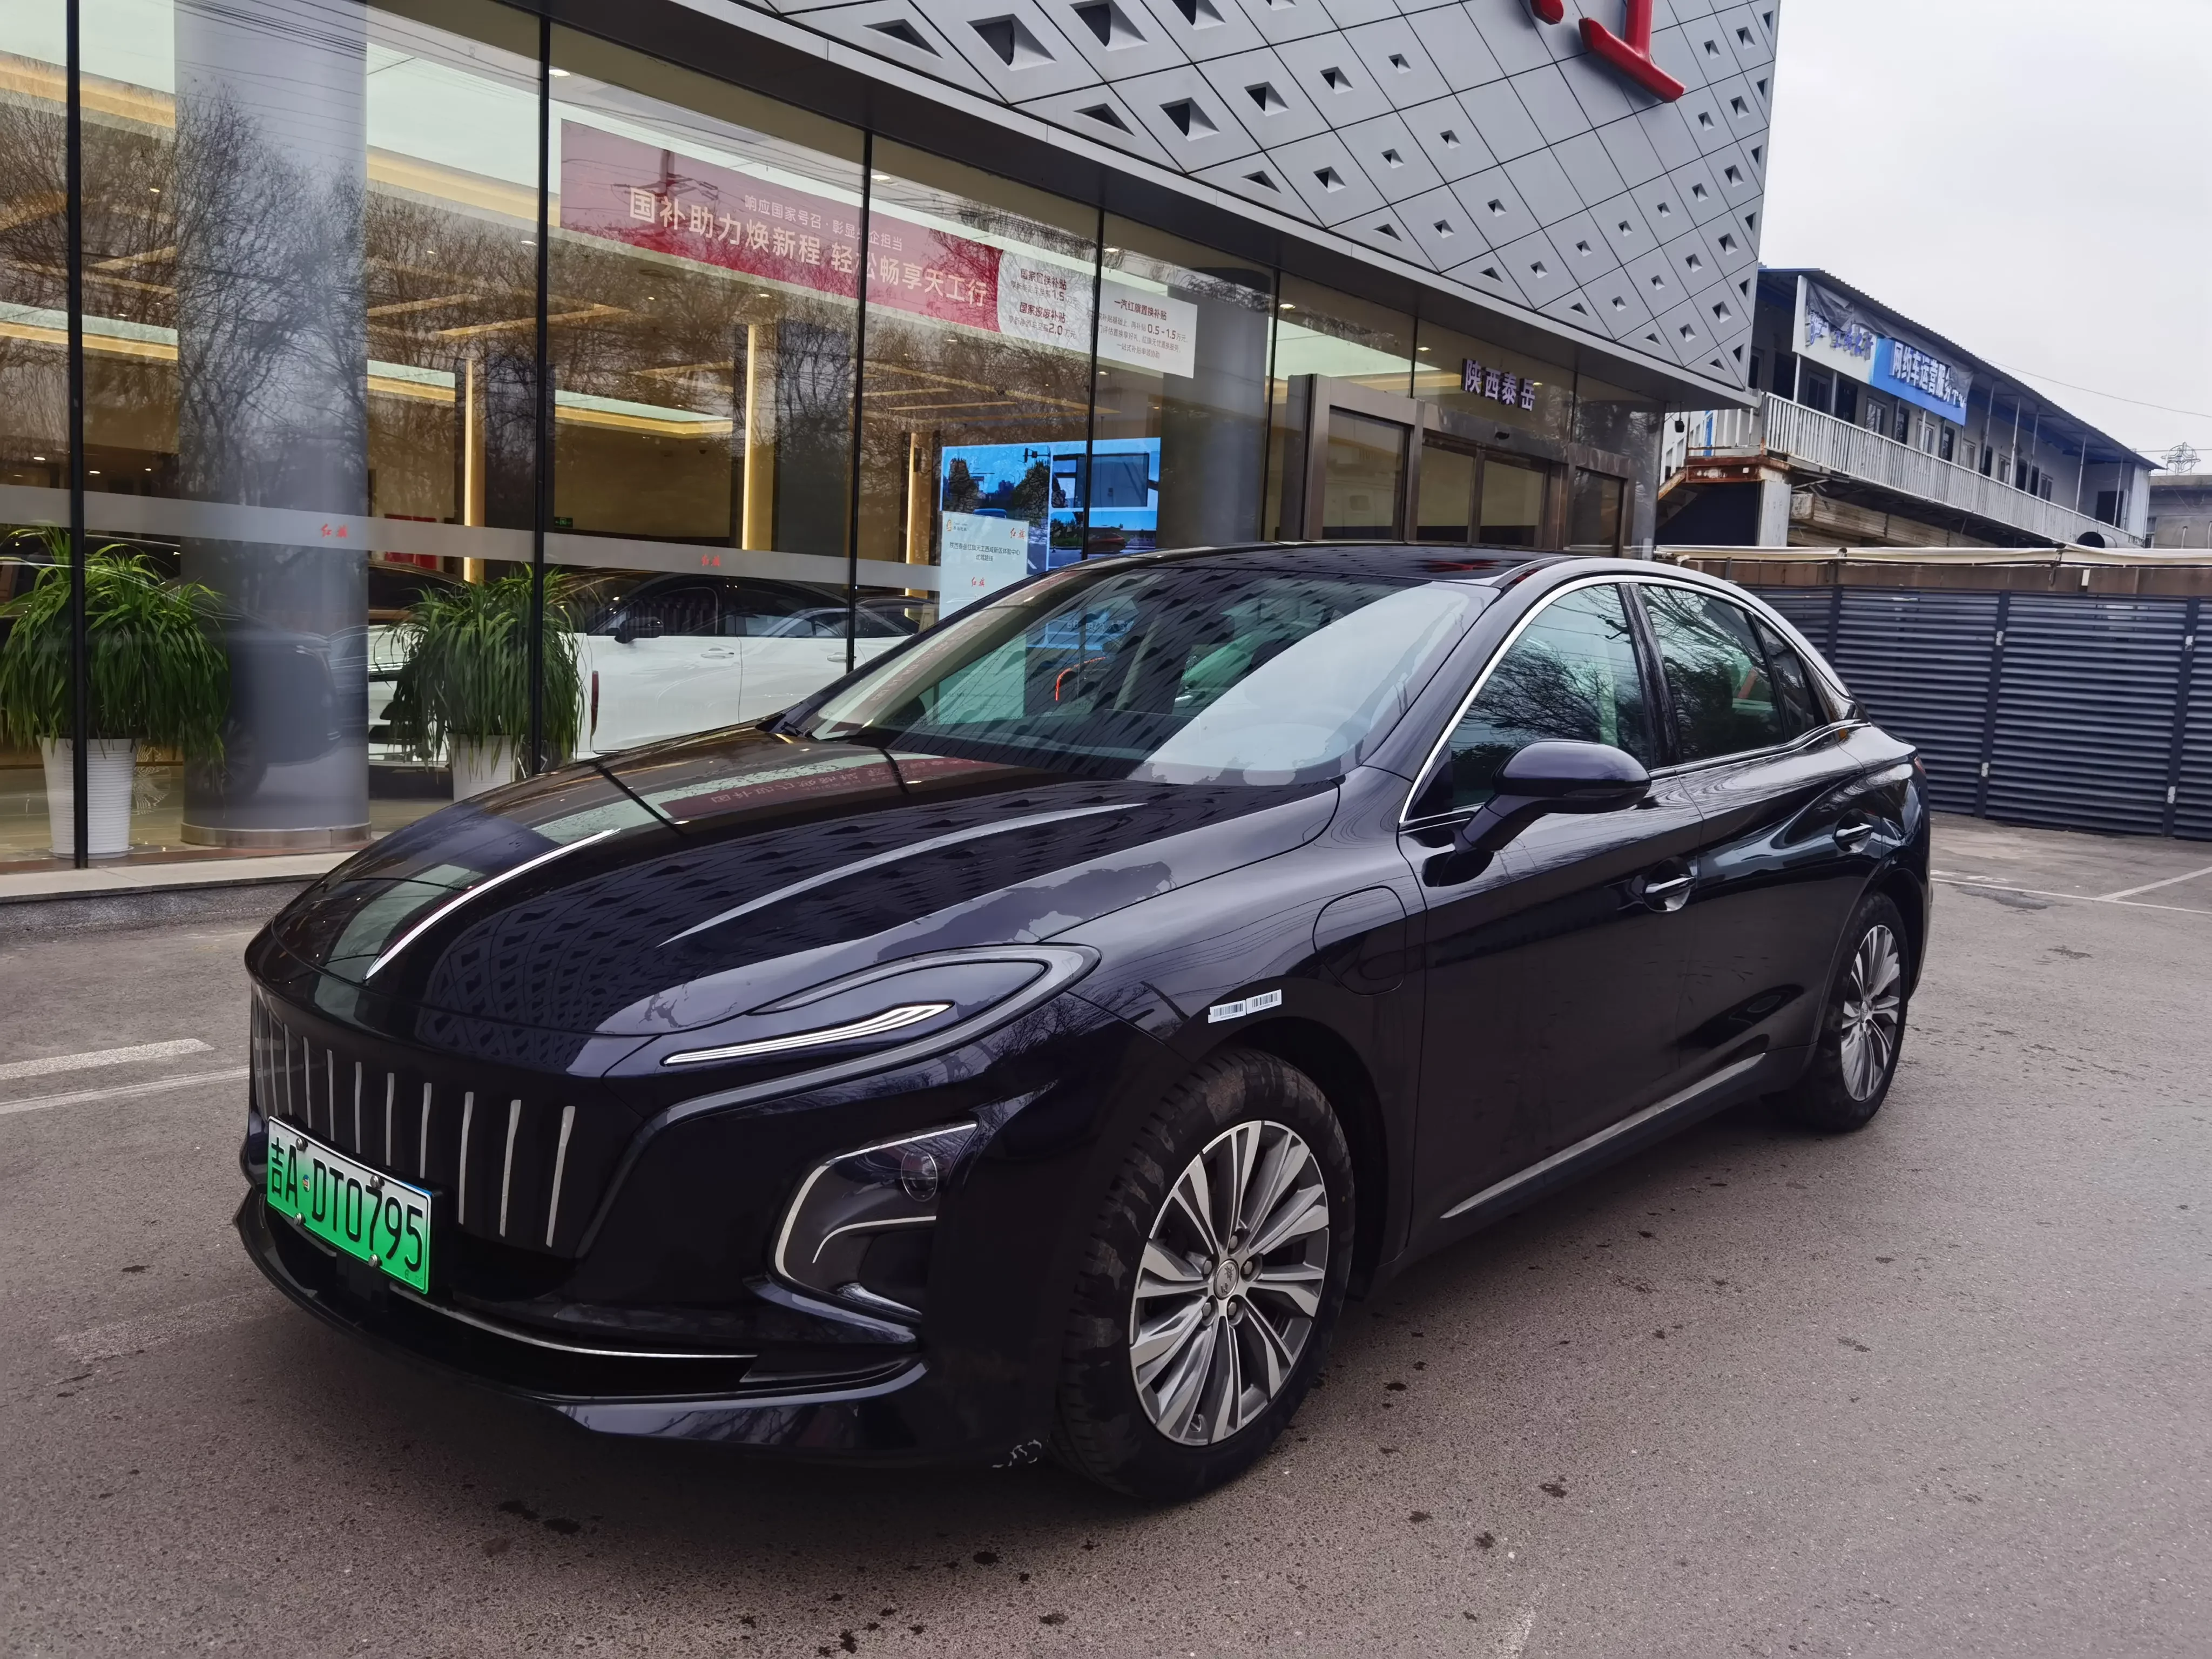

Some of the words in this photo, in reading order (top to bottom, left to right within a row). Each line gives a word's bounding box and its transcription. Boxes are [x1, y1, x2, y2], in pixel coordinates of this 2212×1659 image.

[630, 187, 820, 266] 国补助力焕新程
[1114, 299, 1167, 320] 一汽红旗置换补贴
[1464, 359, 1535, 412] 陕西泰岳
